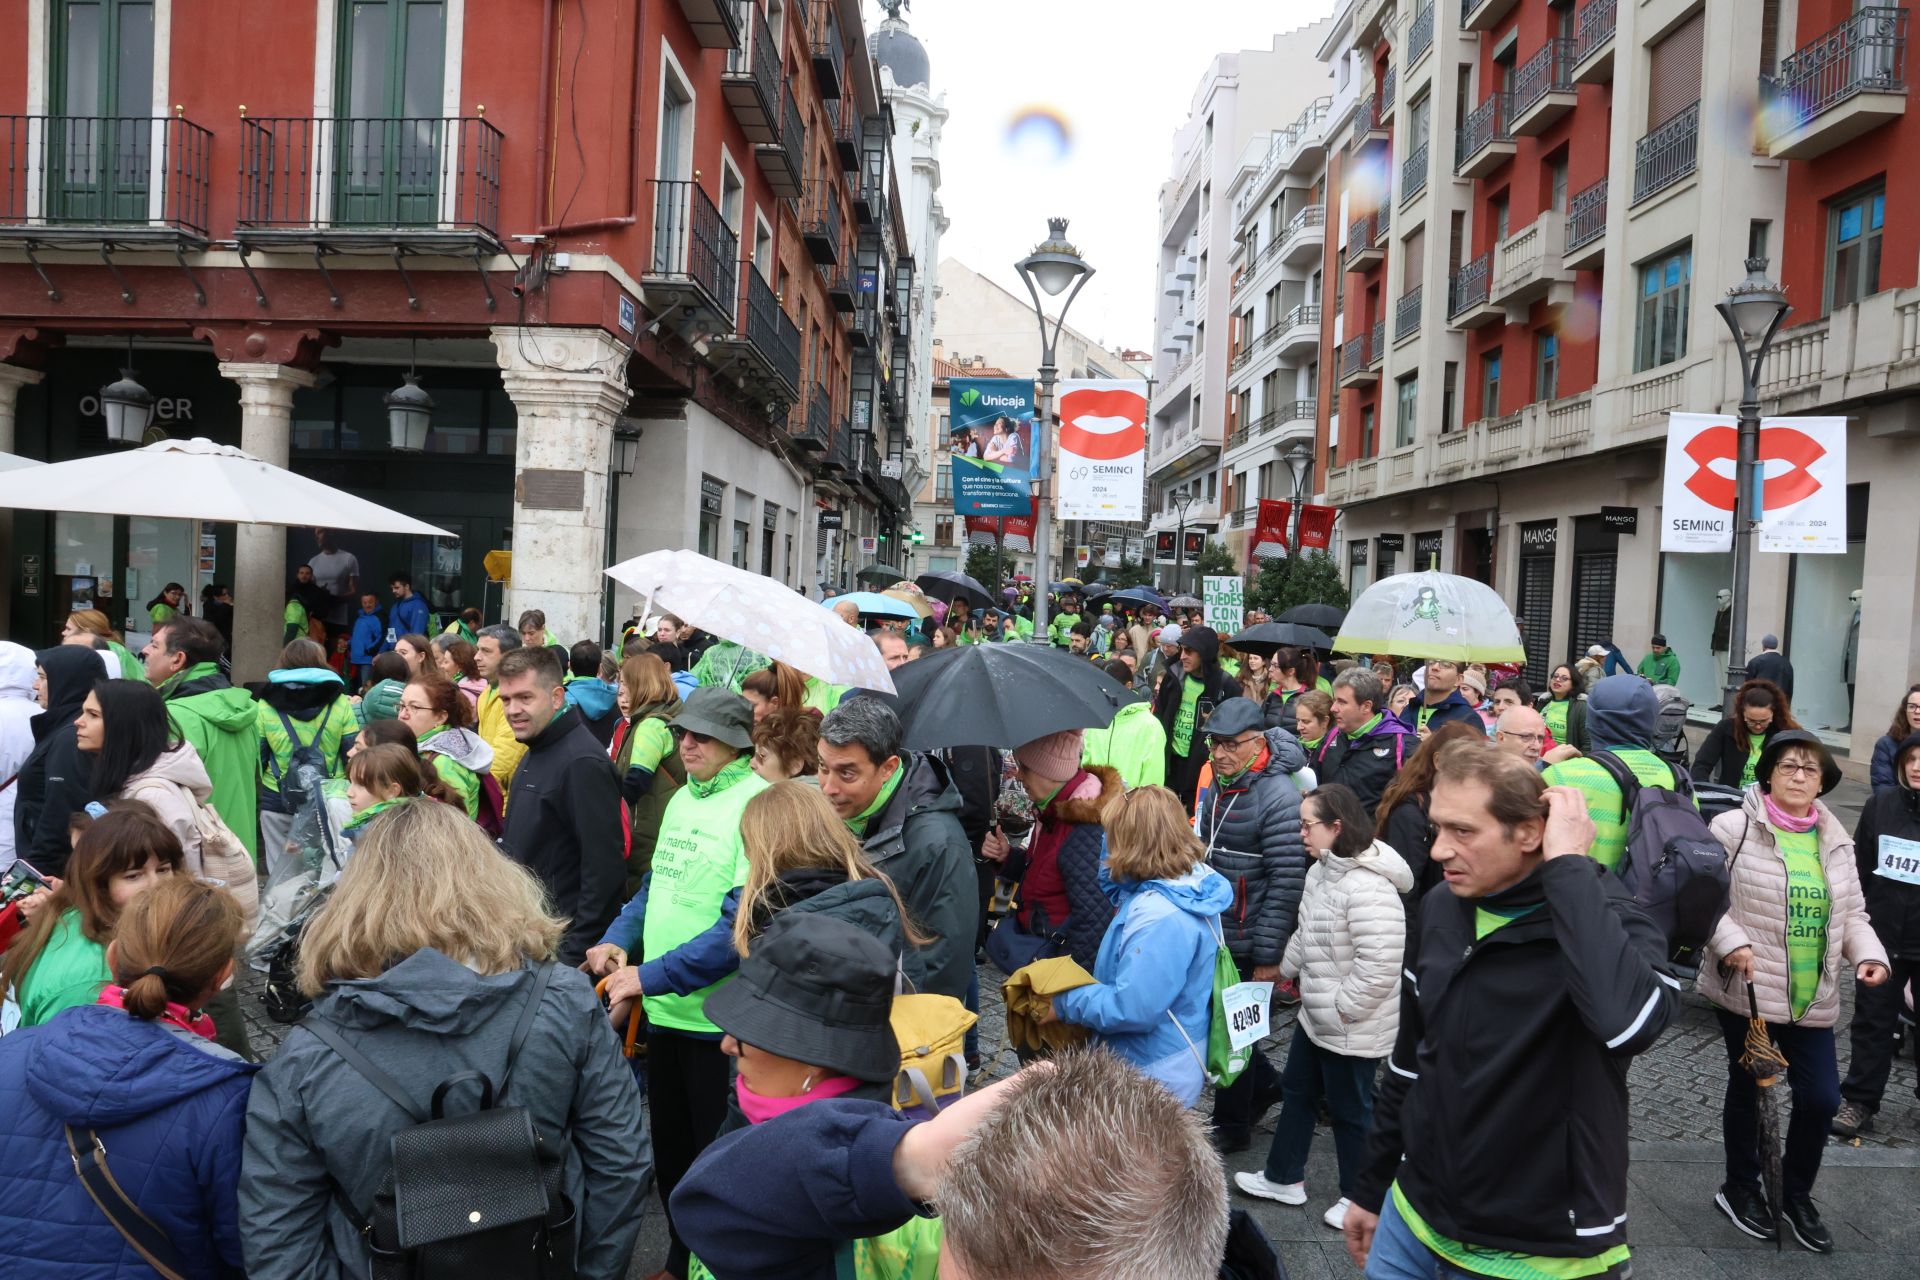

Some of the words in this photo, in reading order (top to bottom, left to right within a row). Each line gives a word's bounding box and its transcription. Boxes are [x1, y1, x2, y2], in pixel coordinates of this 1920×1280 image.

[981, 394, 1026, 409] Unicaja
[1069, 465, 1089, 480] 69
[1092, 465, 1133, 474] SEMINCI
[1605, 515, 1635, 523] MANGO
[1673, 519, 1724, 532] SEMINCI
[1352, 544, 1368, 556] MANG
[1204, 592, 1243, 607] PUEDES
[1212, 606, 1238, 620] CON
[1206, 620, 1240, 634] TODO
[1789, 885, 1827, 900] mar
